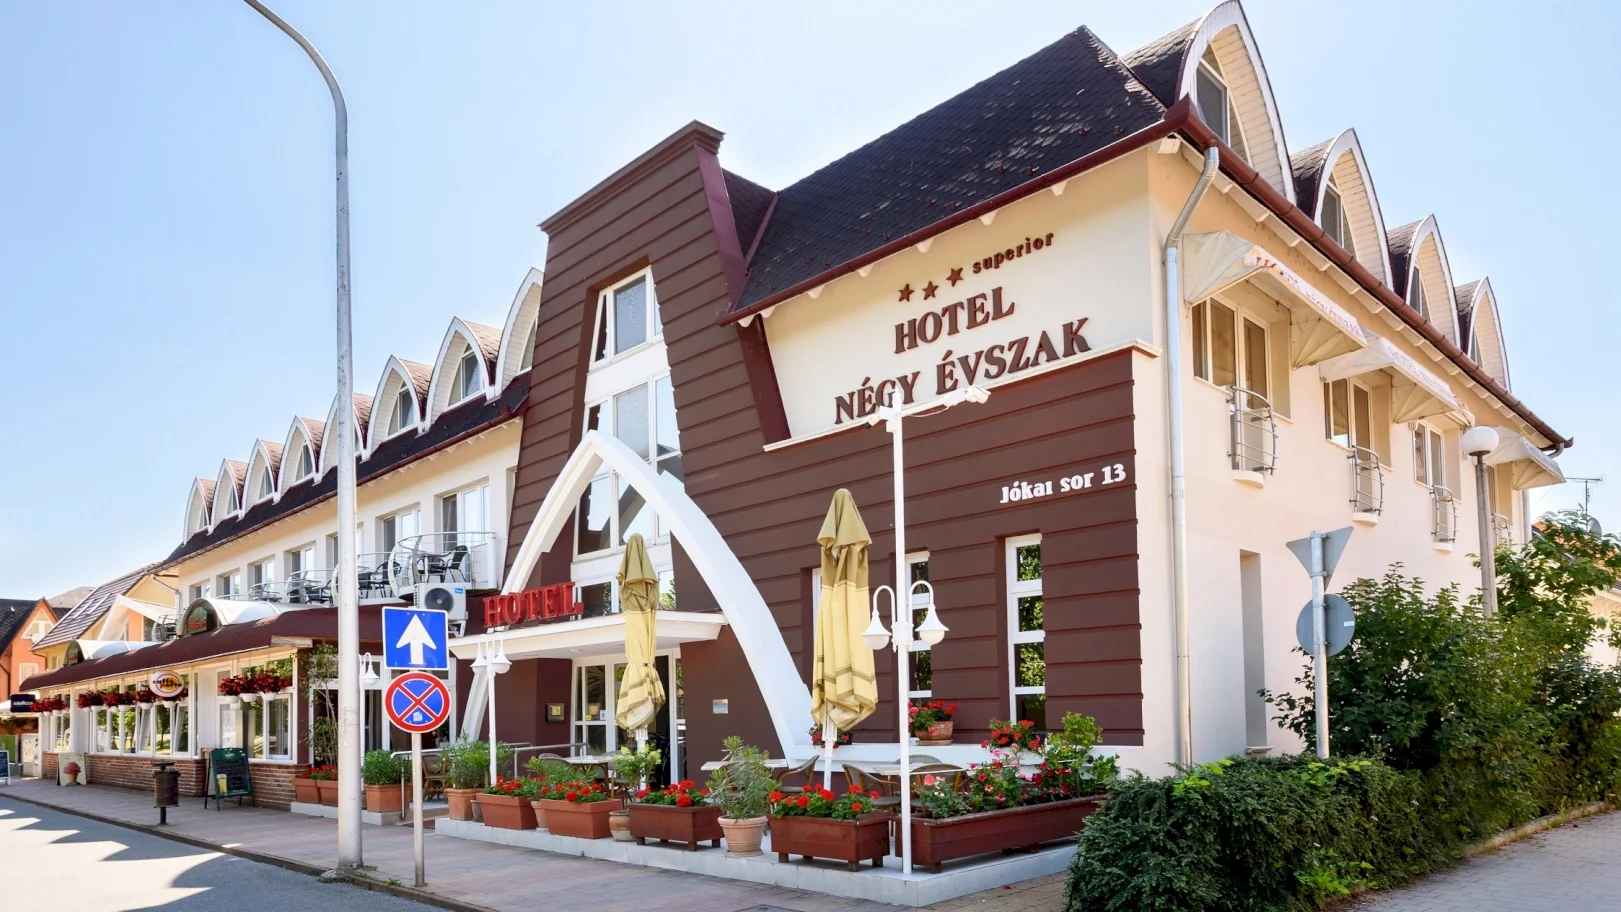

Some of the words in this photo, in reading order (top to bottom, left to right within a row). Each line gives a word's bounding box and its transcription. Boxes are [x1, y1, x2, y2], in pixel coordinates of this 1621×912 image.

[972, 232, 1054, 274] superior
[894, 286, 1015, 354] HOTEL
[834, 371, 920, 424] NÉGY
[936, 317, 1092, 395] ÉVSZAK
[1060, 472, 1094, 492] sor
[1101, 463, 1126, 484] 13
[483, 582, 584, 627] HOTEL
